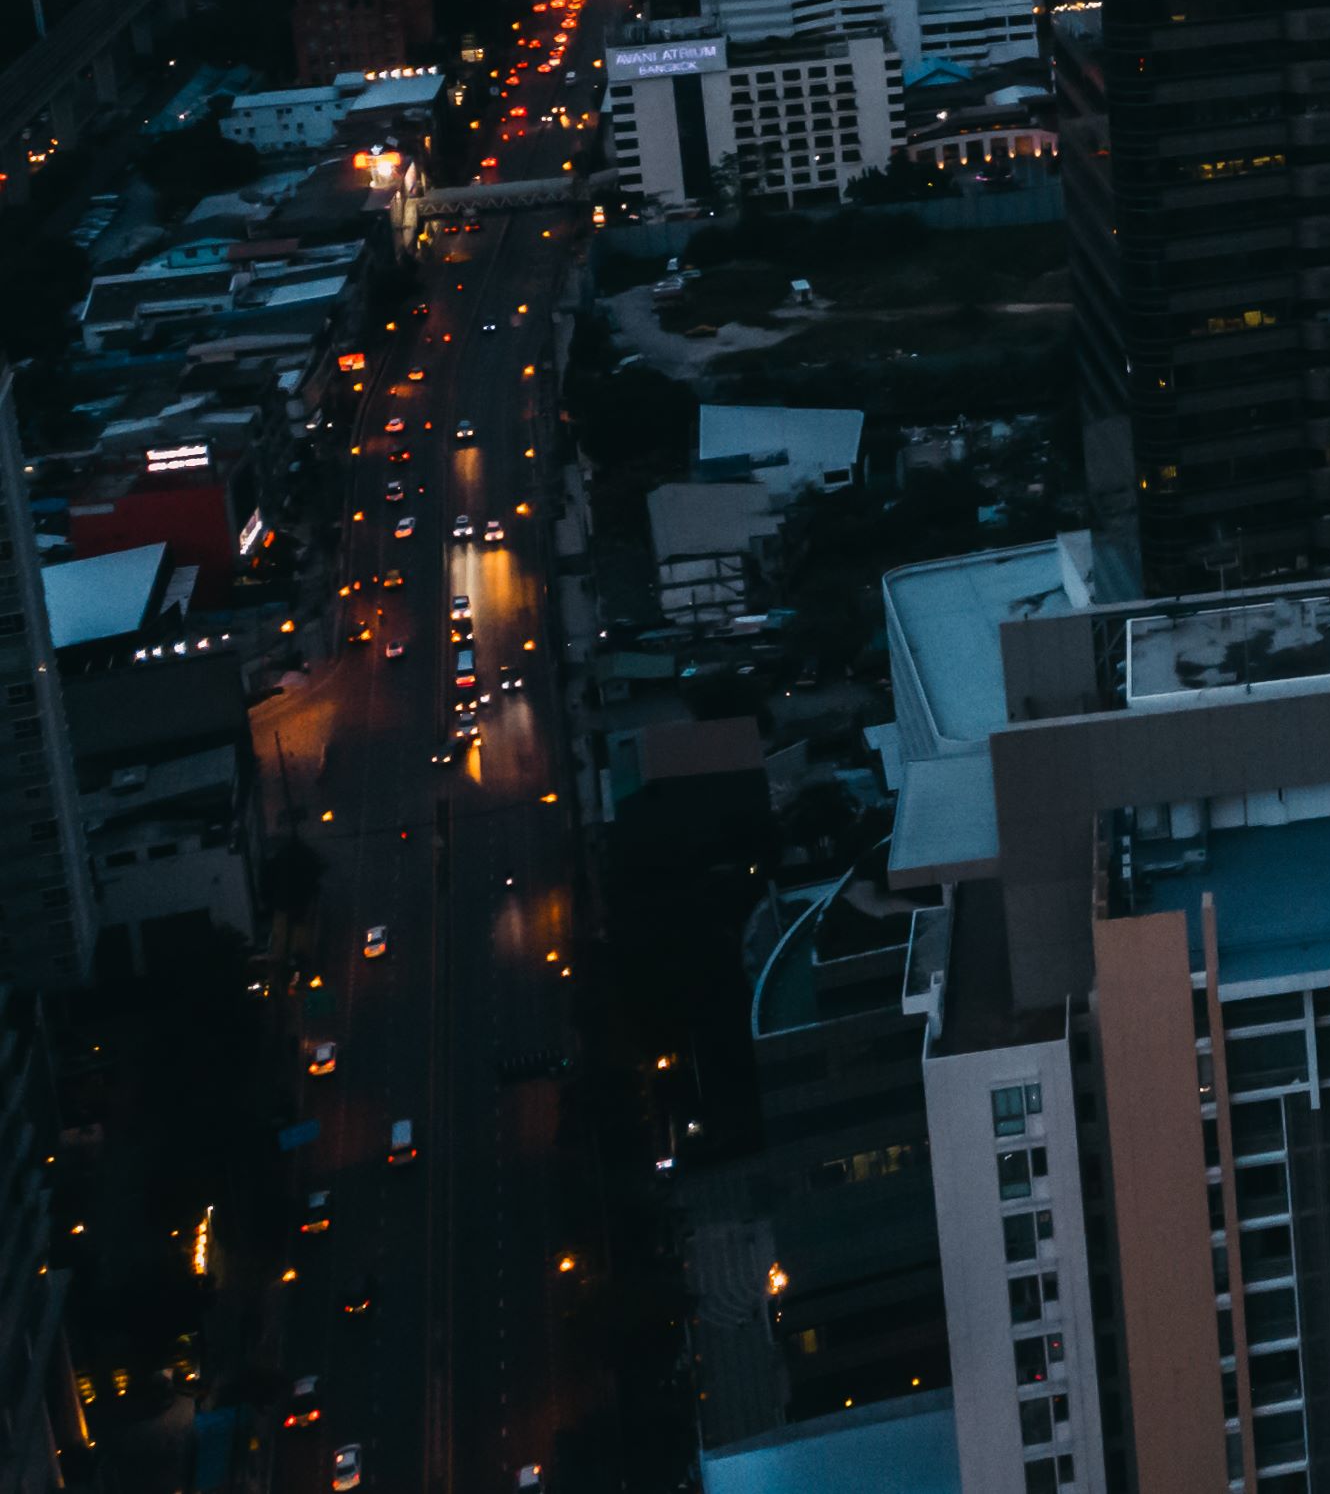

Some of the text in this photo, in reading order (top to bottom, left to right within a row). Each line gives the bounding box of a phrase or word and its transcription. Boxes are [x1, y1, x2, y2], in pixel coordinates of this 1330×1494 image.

[616, 46, 717, 65] AVANI ATRIUM
[639, 61, 698, 75] BANGKOK
